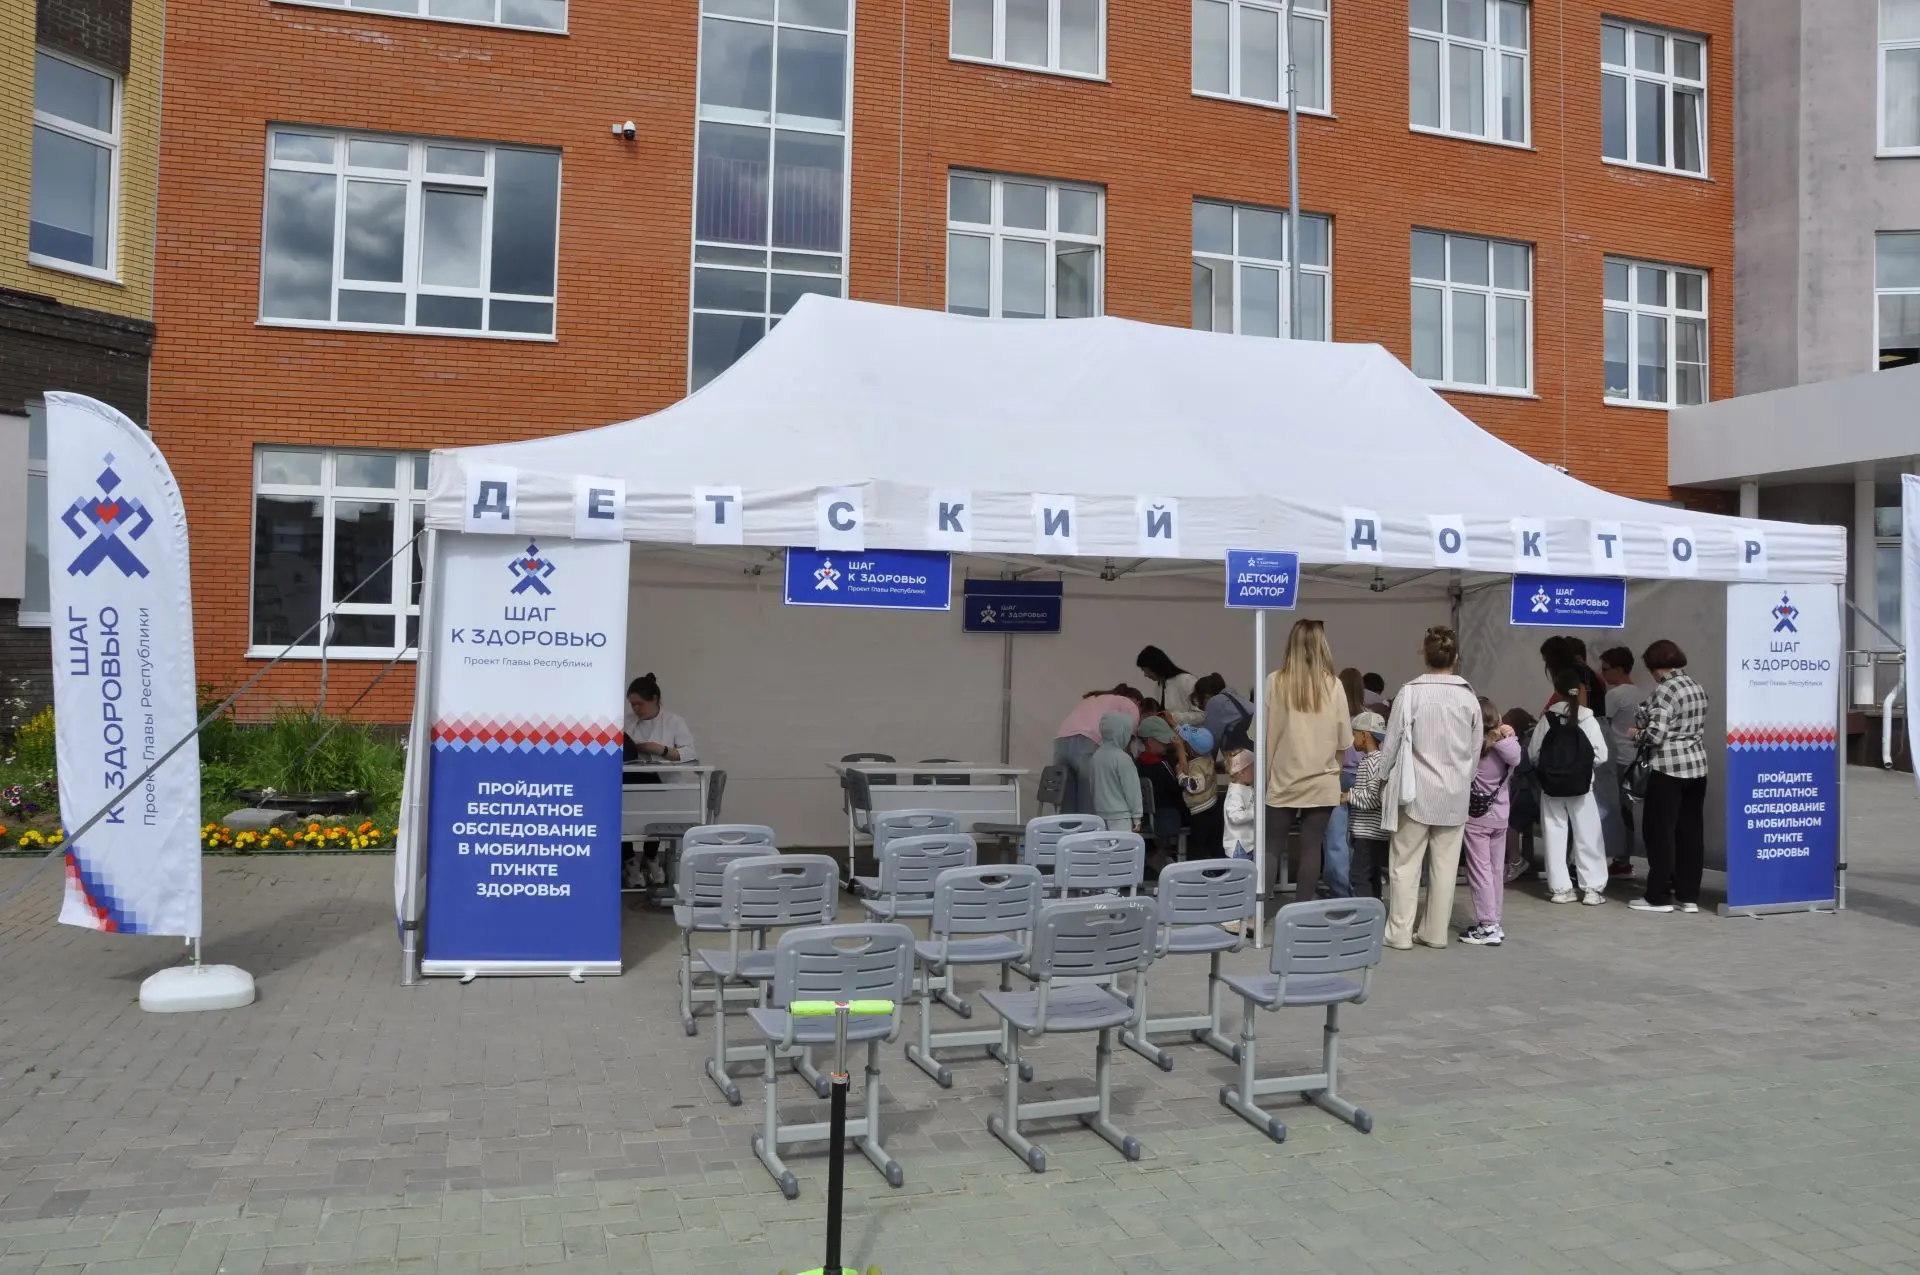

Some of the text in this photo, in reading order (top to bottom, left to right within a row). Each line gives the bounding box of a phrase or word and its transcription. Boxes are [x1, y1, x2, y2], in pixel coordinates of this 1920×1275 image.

[848, 561, 875, 570] ШАГ
[848, 573, 927, 584] К ЗДОРОВЬЮ
[1237, 572, 1289, 584] ДЕТСКИЙ
[1240, 586, 1285, 597] ДОКТОР
[1555, 588, 1575, 596] ШАГ
[1563, 598, 1610, 607] ЗДОРОВЬЮ
[505, 606, 556, 621] ШАГ
[68, 605, 90, 676] ШАГ
[452, 629, 607, 647] К ЗДОРОВЬЮ
[1770, 641, 1800, 653] ШАГ
[137, 607, 154, 708] Республики
[464, 656, 593, 668] Проект Главы Республики
[1742, 659, 1831, 672] К ЗДОРОВЬЮ
[99, 606, 128, 824] К ЗДОРОВЬЮ
[143, 713, 155, 761] Главы
[1757, 771, 1813, 784] ПРОЙДИТЕ
[478, 780, 574, 798] ПРОЙДИТЕ
[1752, 788, 1818, 799] БЕСПЛАТНОЕ
[467, 802, 583, 817] БЕСПЛАТНОЕ
[1744, 802, 1826, 814] ОБСЛЕДОВАНИЕ
[1747, 817, 1822, 829] В МОБИЛЬНОМ
[452, 822, 597, 838] ОБСЛЕДОВАНИЕ
[1764, 832, 1803, 843] ПУНКТЕ
[458, 842, 591, 857] В МОБИЛЬНОМ
[1756, 847, 1810, 860] ЗДОРОВЬЯ
[490, 863, 558, 876] ПУНКТЕ
[476, 883, 571, 898] ЗДОРОВЬЯ
